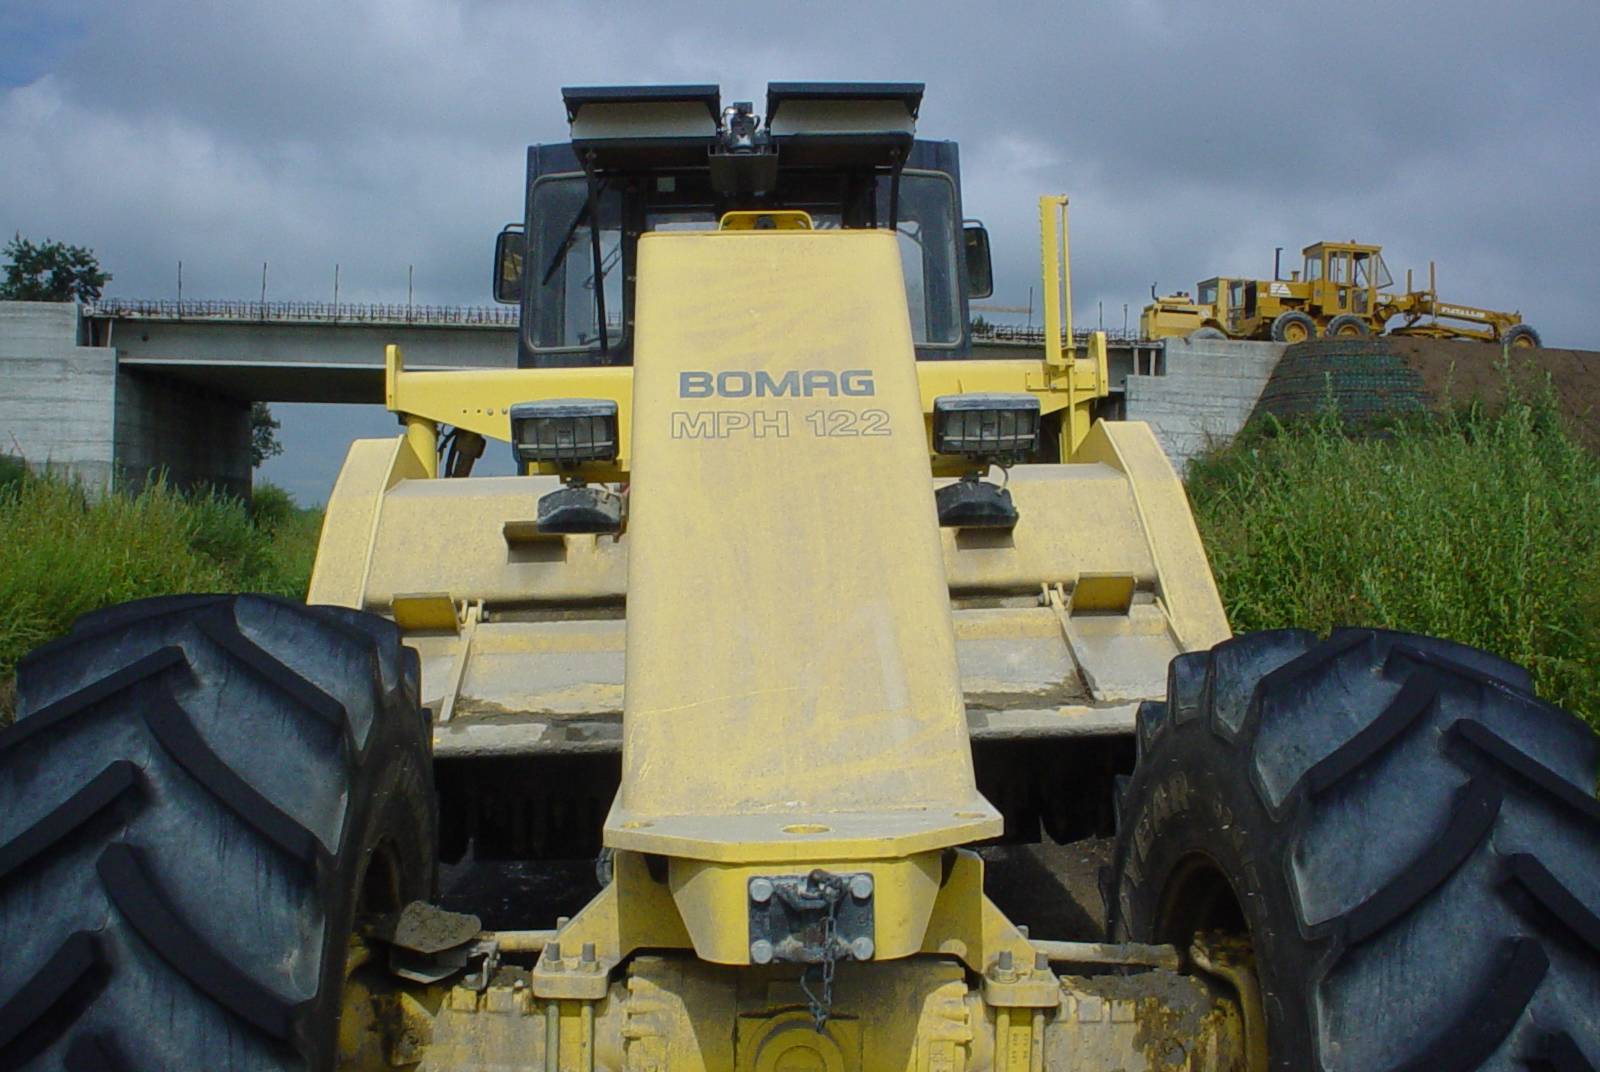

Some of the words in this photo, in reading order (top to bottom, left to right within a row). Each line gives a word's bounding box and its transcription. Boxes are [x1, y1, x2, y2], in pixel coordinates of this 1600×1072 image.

[680, 370, 875, 398] BOMAG
[671, 410, 790, 439] MPH
[806, 409, 892, 437] 122
